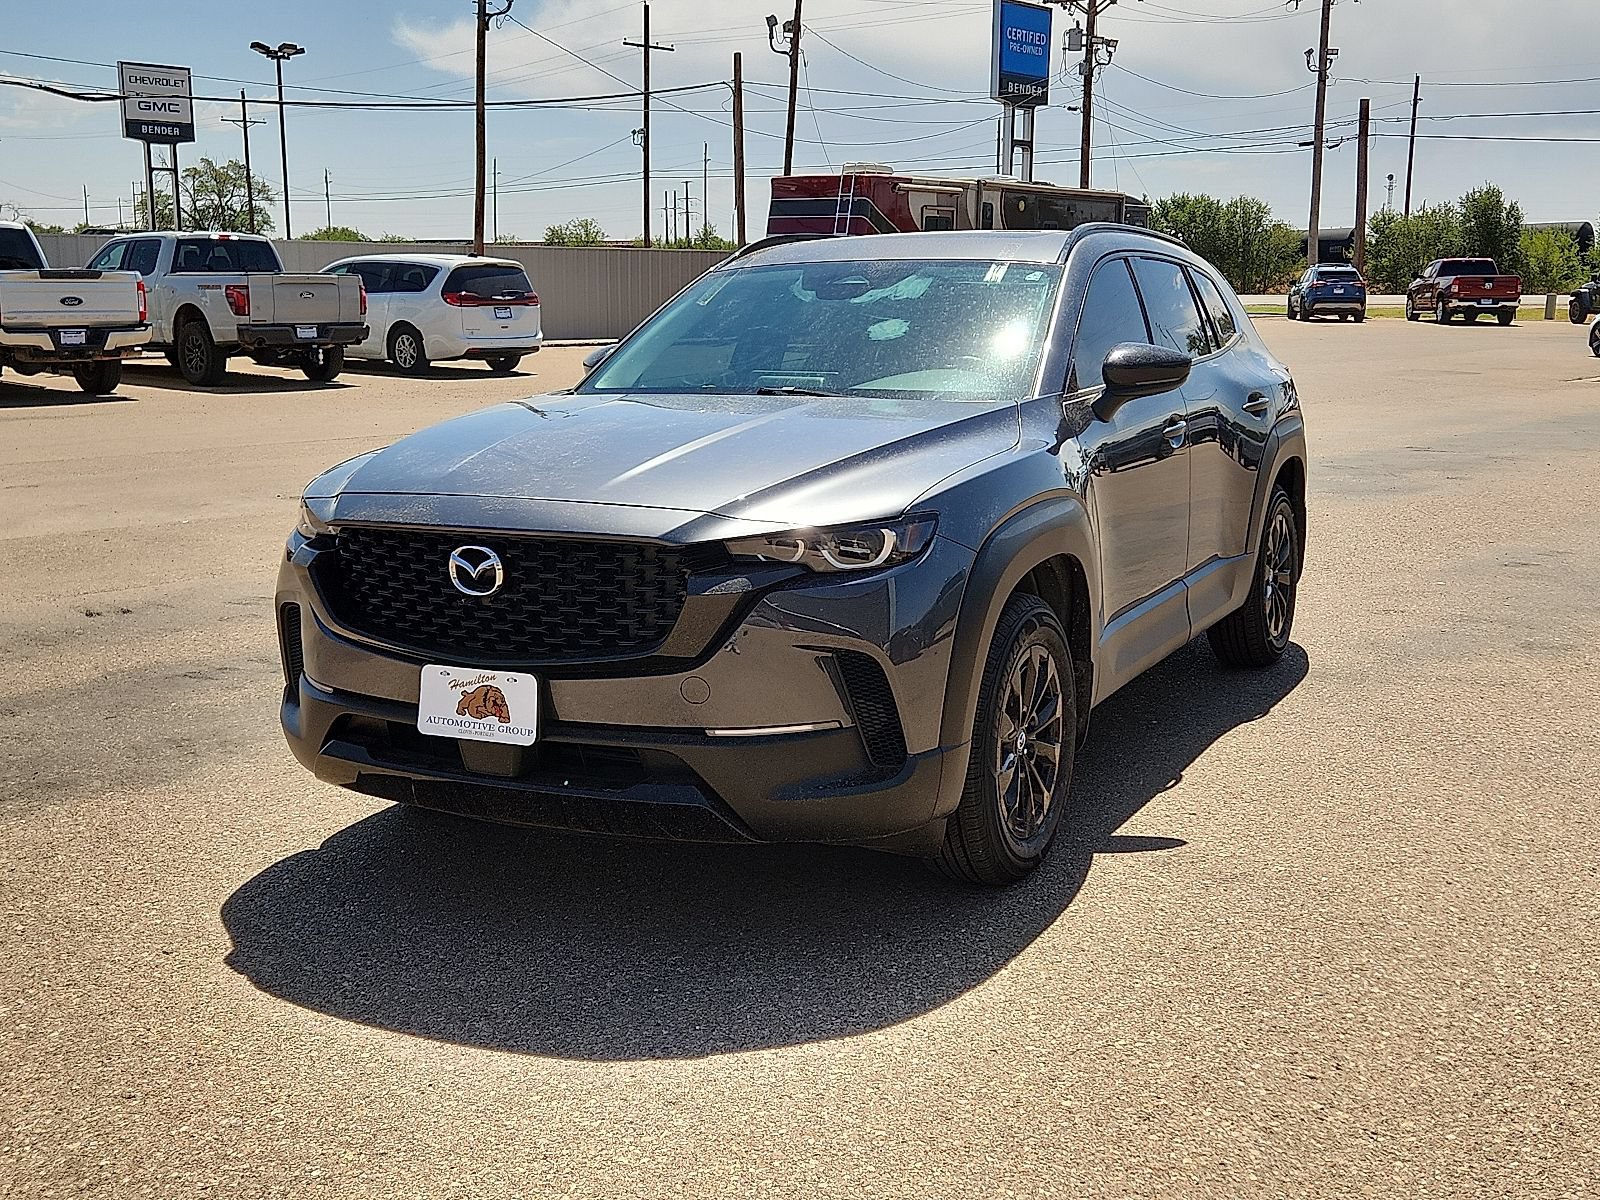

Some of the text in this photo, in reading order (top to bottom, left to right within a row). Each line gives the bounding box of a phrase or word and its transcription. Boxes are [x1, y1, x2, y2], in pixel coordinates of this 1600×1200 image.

[1006, 27, 1047, 45] CERTIFIED
[1009, 42, 1043, 56] PRE-OWNED
[128, 75, 185, 88] CHEVROLET
[1008, 82, 1042, 96] BENDER
[137, 101, 181, 113] GMC
[141, 125, 180, 136] BENDER
[448, 674, 497, 691] Hamilton
[426, 716, 534, 737] AUTOMOTIVE GROUP
